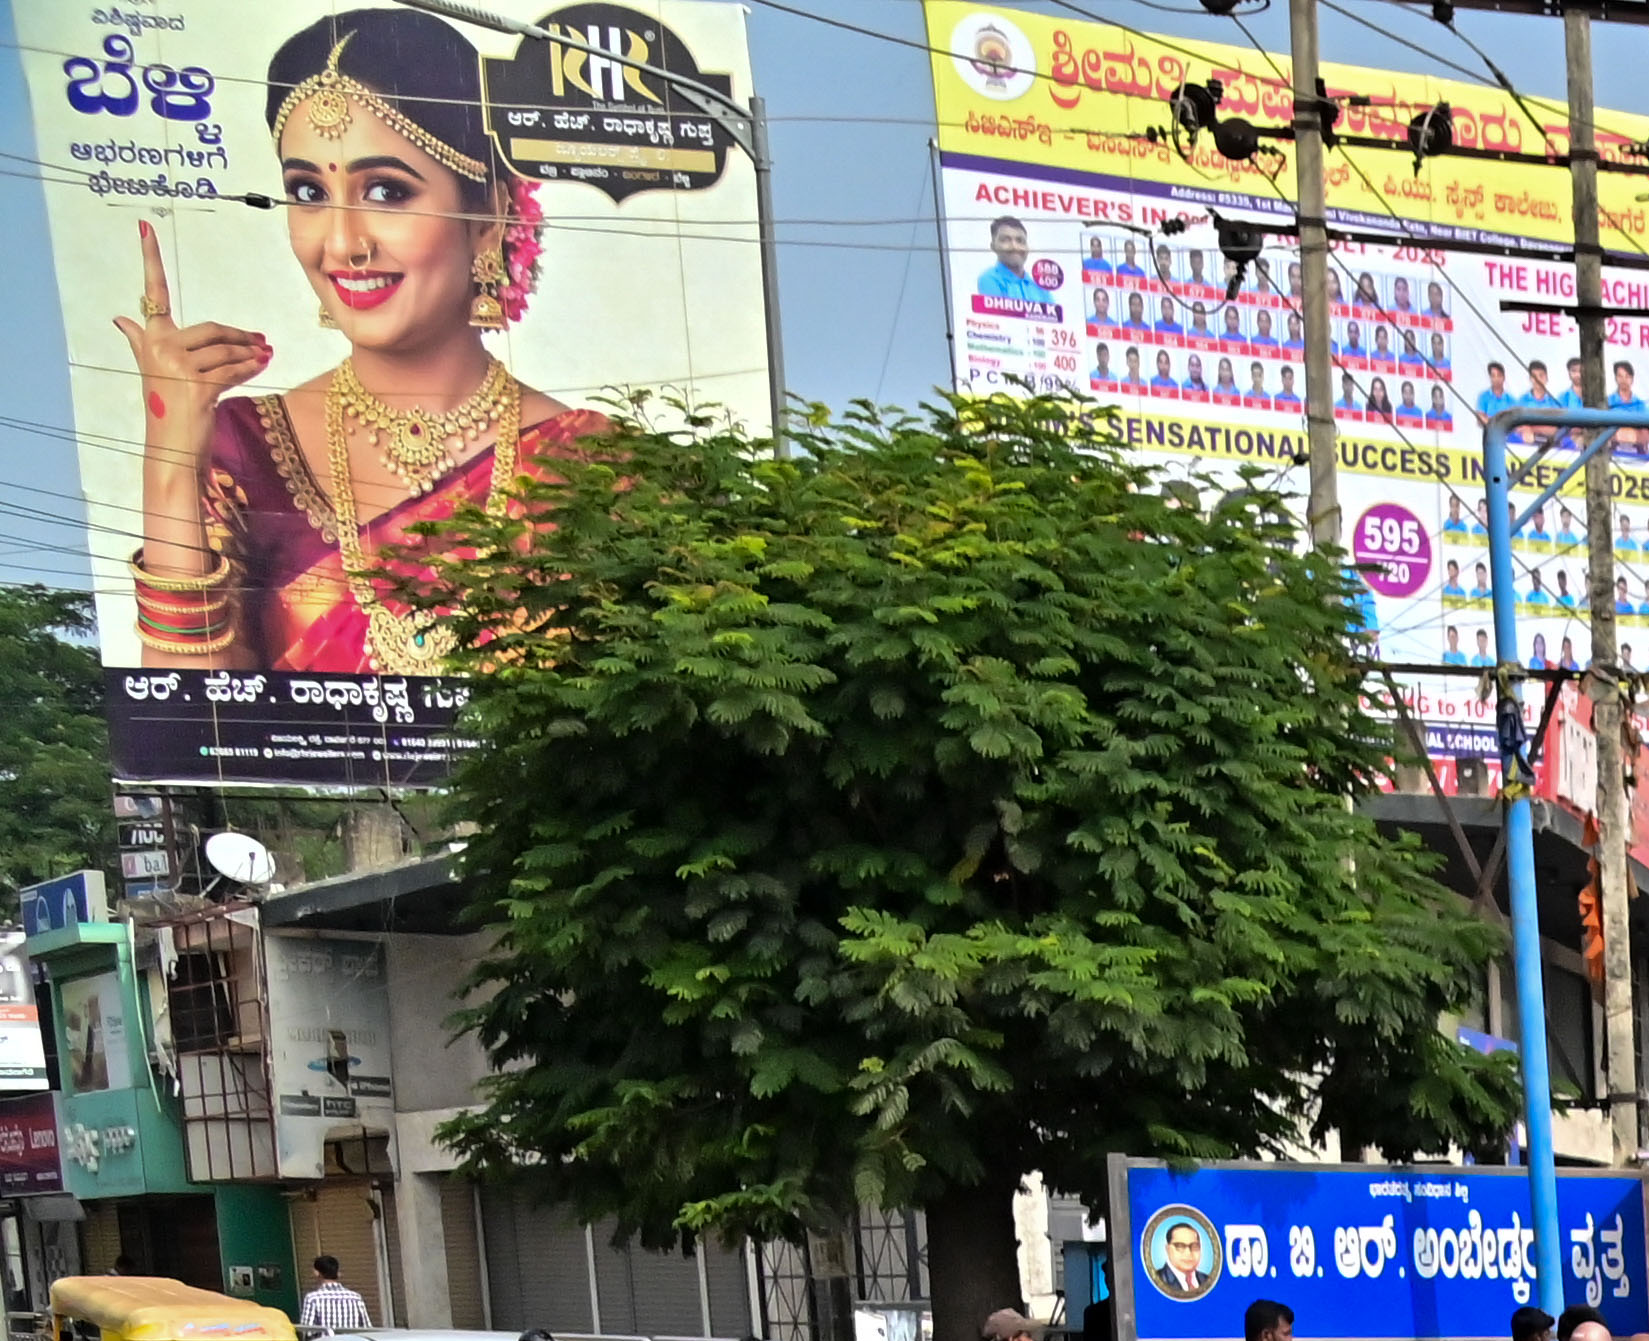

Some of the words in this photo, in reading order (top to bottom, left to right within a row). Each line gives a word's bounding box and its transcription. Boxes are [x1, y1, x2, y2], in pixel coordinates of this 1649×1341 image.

[1050, 31, 1186, 109] ಶ್ರೀಮತಿ
[64, 34, 222, 144] ಬೆಳ್ಳಿ
[975, 183, 1132, 220] ACHIEVER'S
[1143, 207, 1167, 226] IN
[1485, 261, 1528, 292] THE
[984, 296, 1043, 314] DHRUVA
[1052, 328, 1077, 348] 396
[1054, 356, 1077, 372] 400
[1364, 516, 1421, 553] 595
[125, 671, 190, 701] ಆರ್.
[289, 675, 416, 723] ರಾಧಾಕೃಷ್ಣ
[1438, 698, 1455, 717] to
[1223, 1224, 1277, 1279] ಡಾ.
[1288, 1224, 1324, 1279] ಬಿ.
[1334, 1213, 1405, 1280] ಆರ್.
[1570, 1210, 1630, 1307] ವೃತ್ತ
